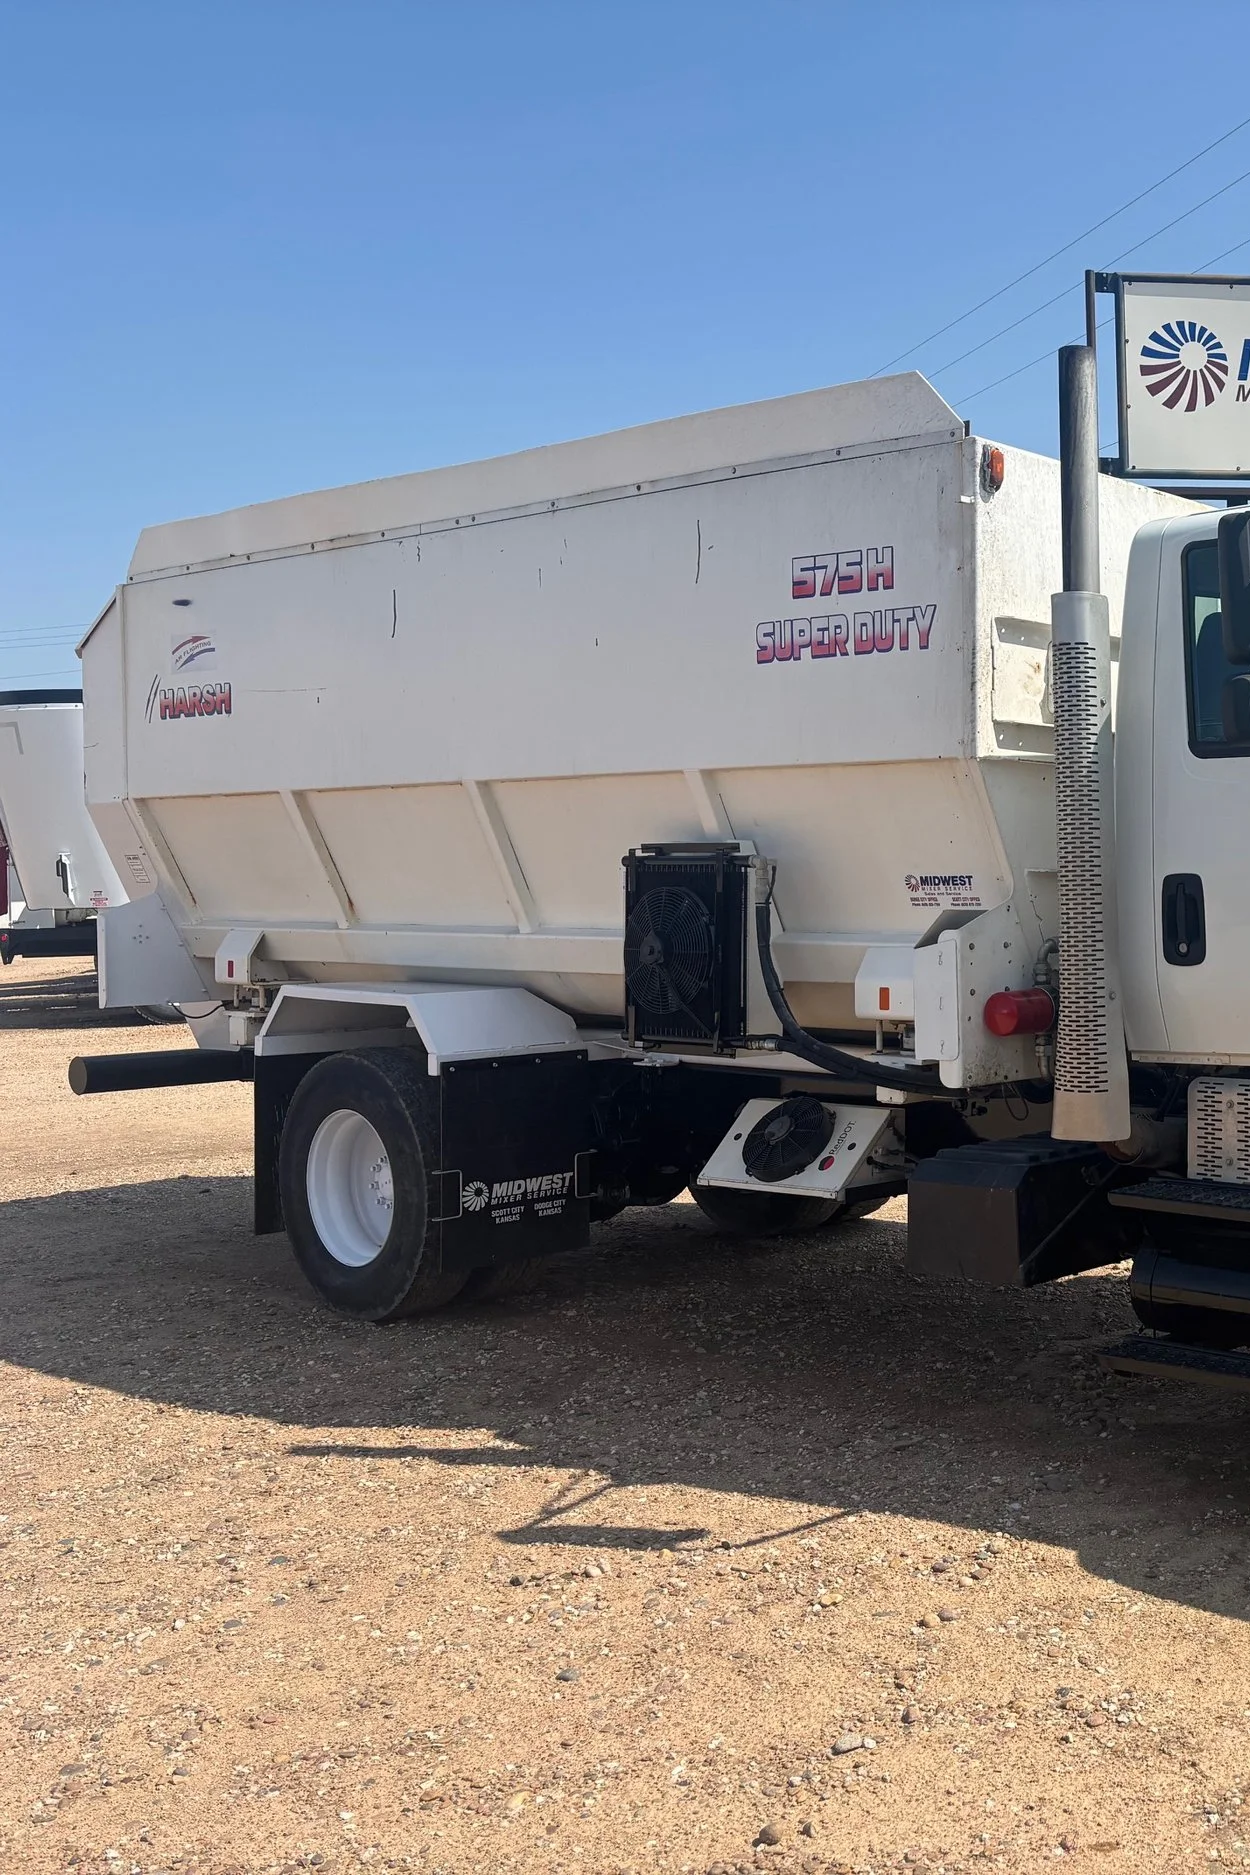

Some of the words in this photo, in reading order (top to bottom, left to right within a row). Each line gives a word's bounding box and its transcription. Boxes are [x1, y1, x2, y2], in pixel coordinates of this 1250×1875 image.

[755, 613, 850, 664] SUPER
[853, 604, 937, 655] DUTY
[159, 682, 232, 720] HARSH
[919, 875, 973, 886] MIDWEST
[491, 1172, 574, 1198] MIDWEST
[490, 1194, 522, 1205] MIXER
[527, 1187, 568, 1199] SERVICE
[533, 1201, 553, 1210] DODGE
[553, 1199, 567, 1207] CITY
[491, 1207, 510, 1217] SCOTT
[511, 1206, 525, 1214] CITY
[538, 1207, 562, 1216] KANSAS
[495, 1214, 520, 1224] KANSAS
